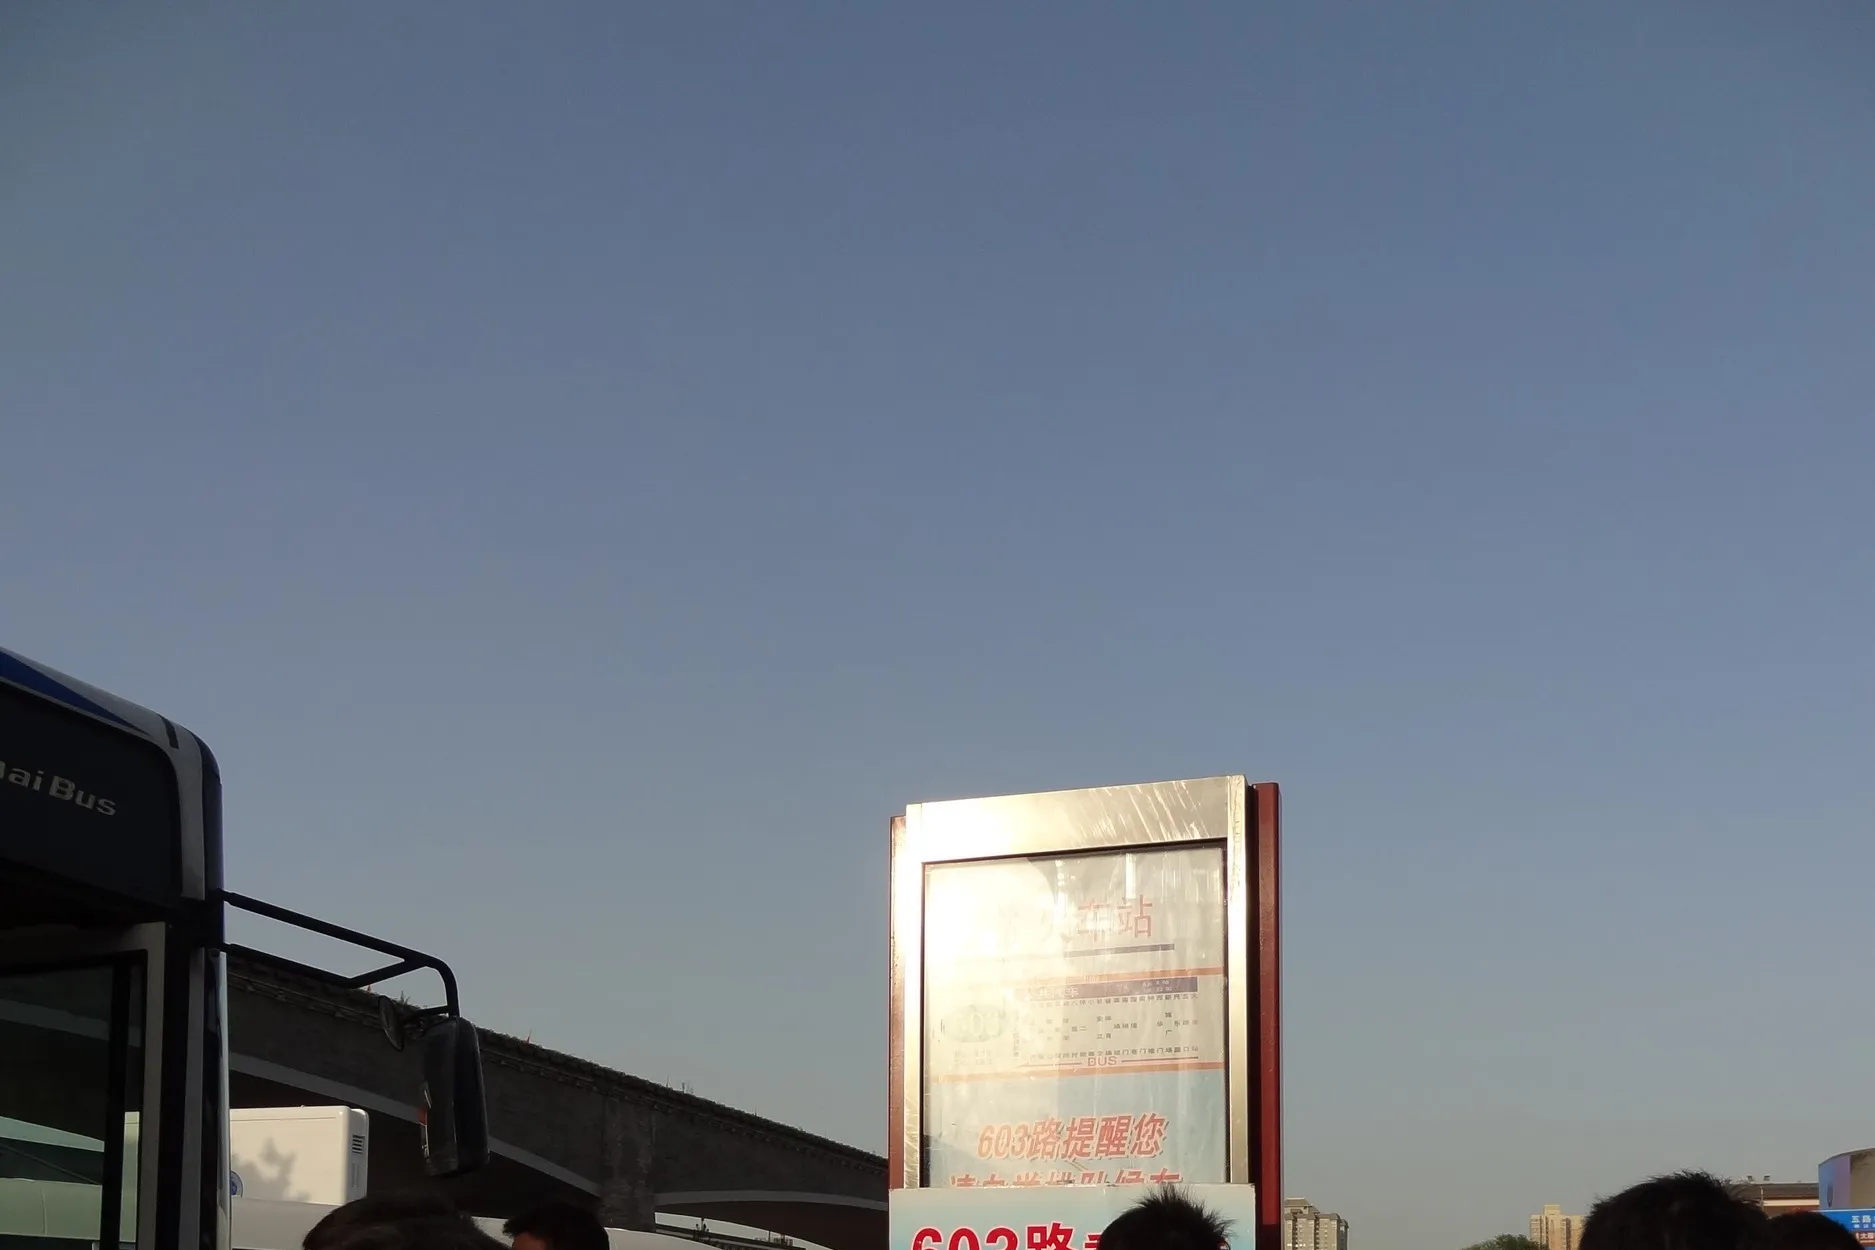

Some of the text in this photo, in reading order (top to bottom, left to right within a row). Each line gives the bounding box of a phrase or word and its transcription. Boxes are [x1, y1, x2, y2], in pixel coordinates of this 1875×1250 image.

[49, 775, 117, 816] Bus
[1088, 1055, 1117, 1067] BUS
[976, 1113, 1167, 1161] 603路提醒您
